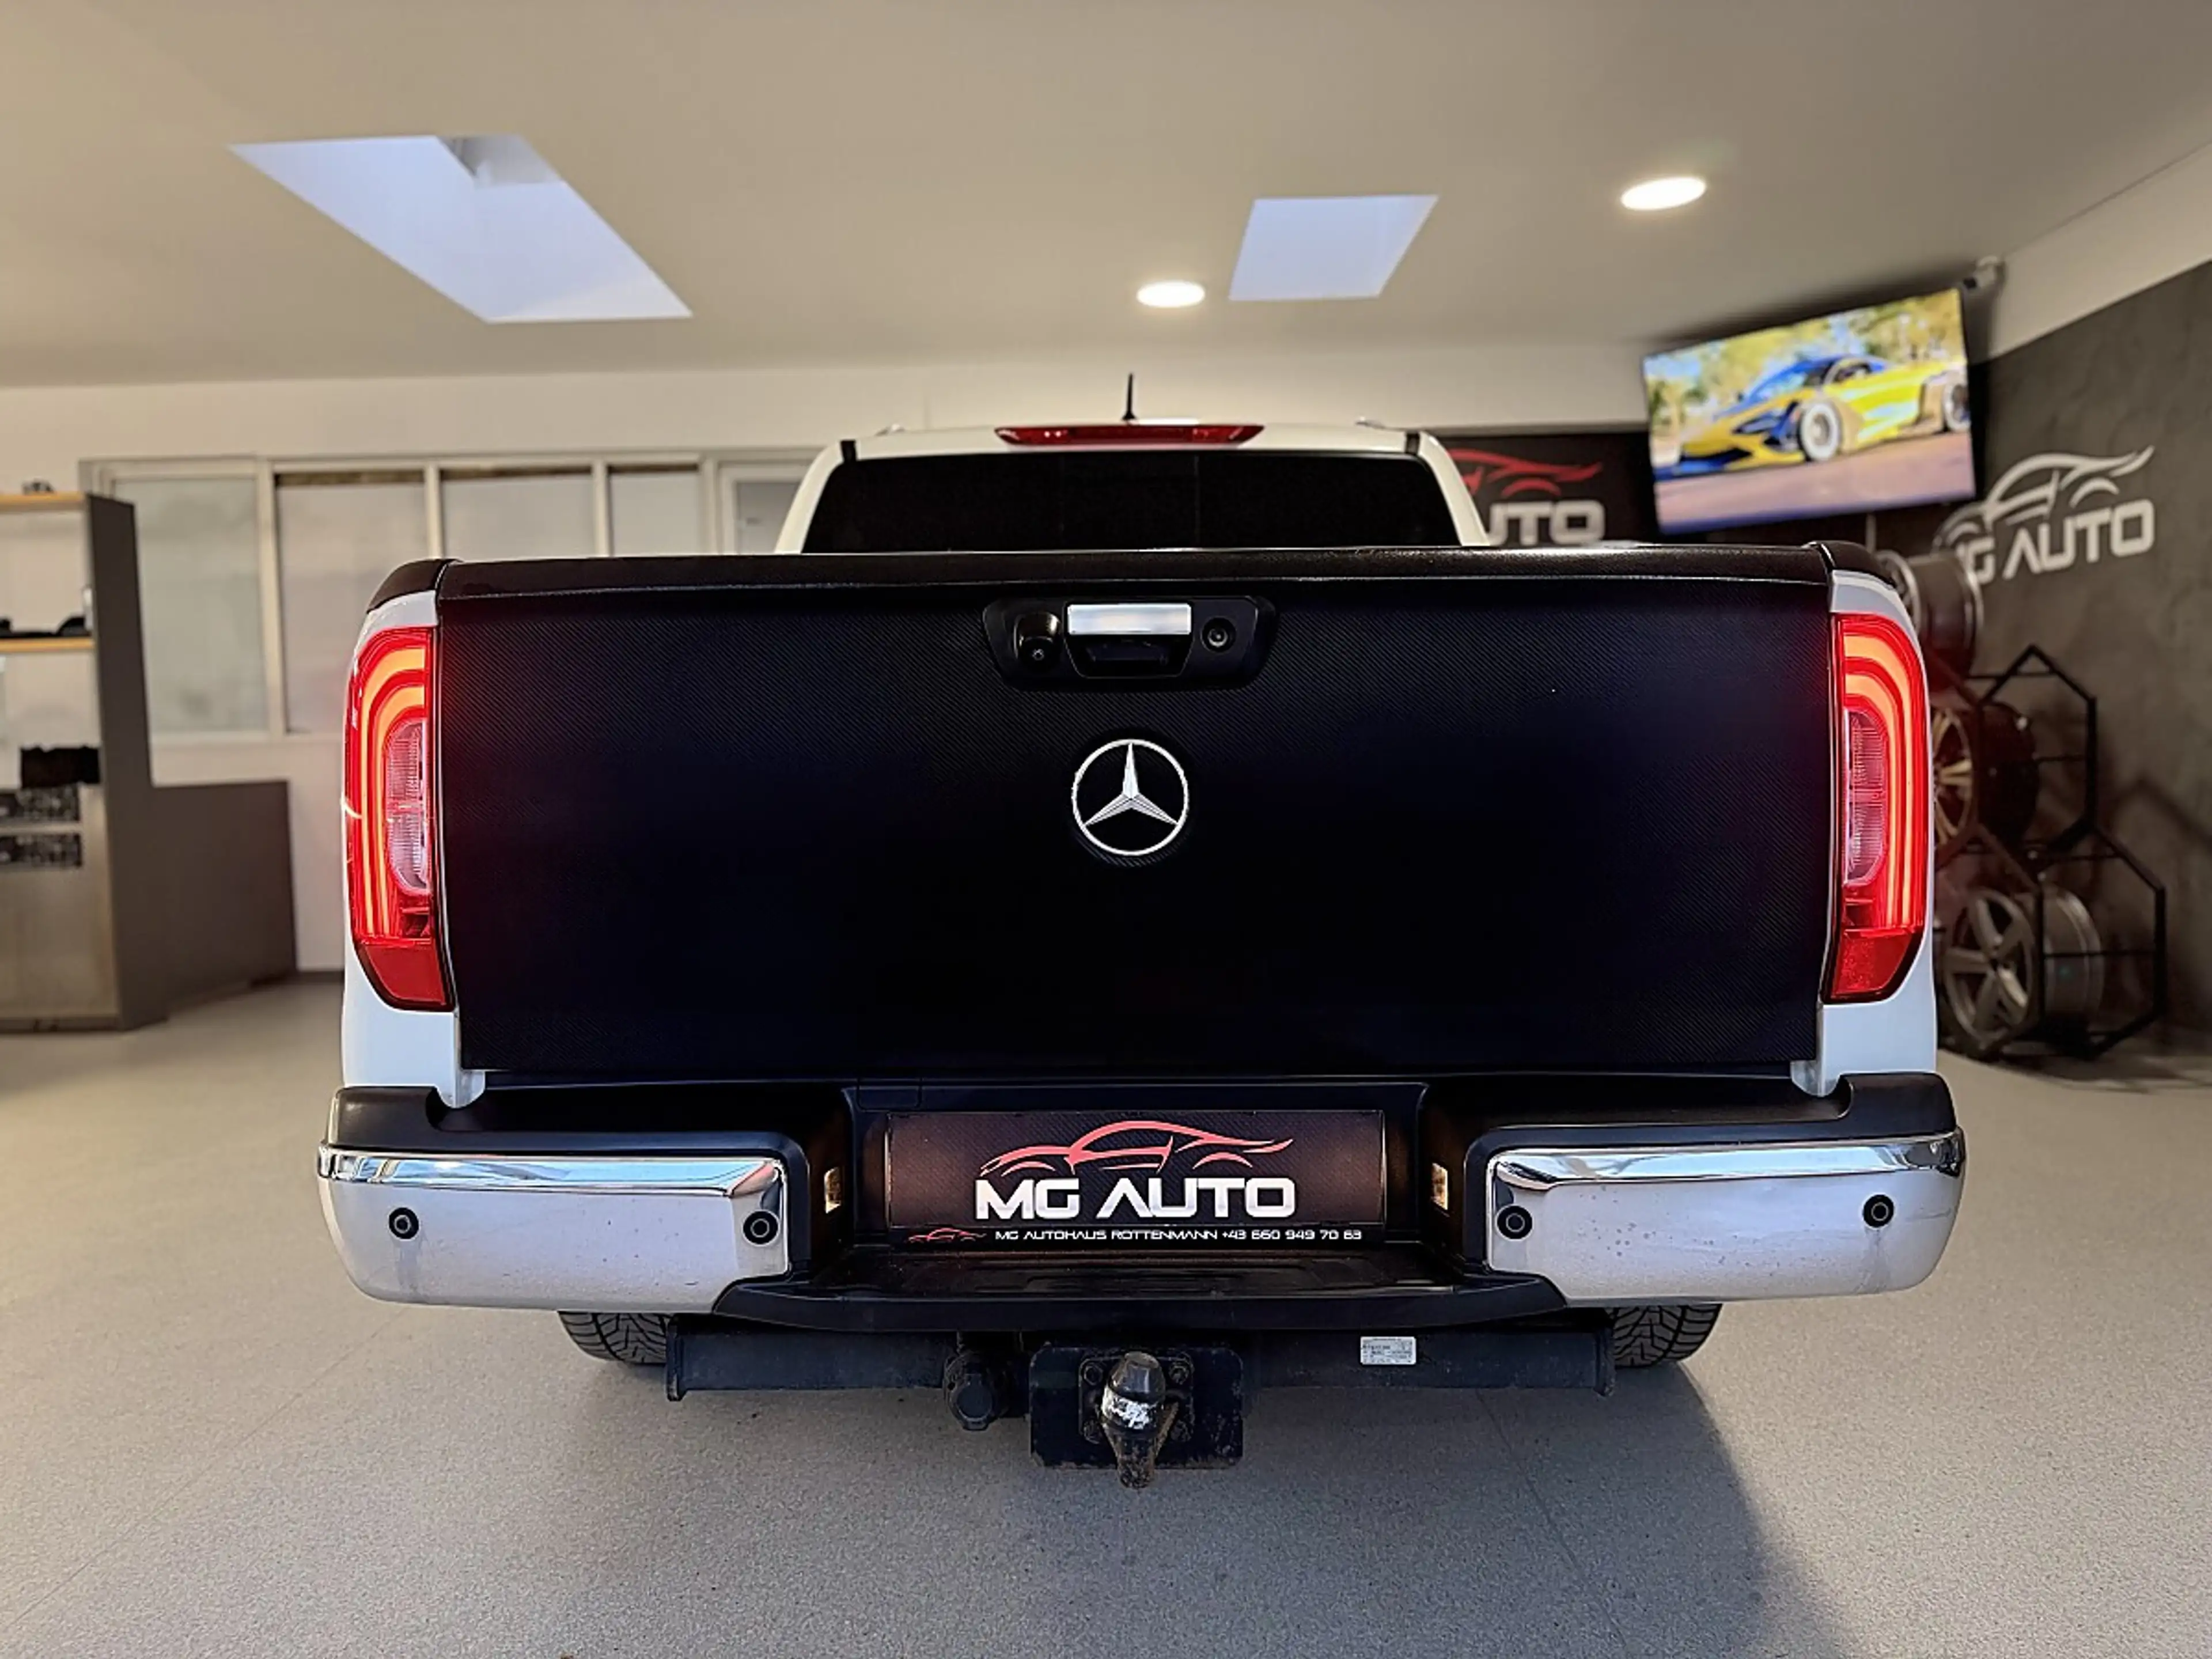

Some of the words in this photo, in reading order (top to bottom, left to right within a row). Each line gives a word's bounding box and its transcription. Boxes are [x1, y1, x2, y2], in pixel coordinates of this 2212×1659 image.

[1486, 499, 1605, 547] UTO
[1956, 536, 1995, 585] G
[2002, 499, 2155, 581] AUTO
[975, 1178, 1080, 1220] MG
[1096, 1177, 1296, 1219] AUTO
[995, 1230, 1019, 1240] MG
[1023, 1230, 1107, 1240] AUTOHAUS
[1111, 1230, 1218, 1240] ROTTENMANN
[1222, 1229, 1247, 1240] +43
[1251, 1229, 1281, 1240] 660
[1285, 1229, 1315, 1240] 949
[1320, 1229, 1339, 1240] 70
